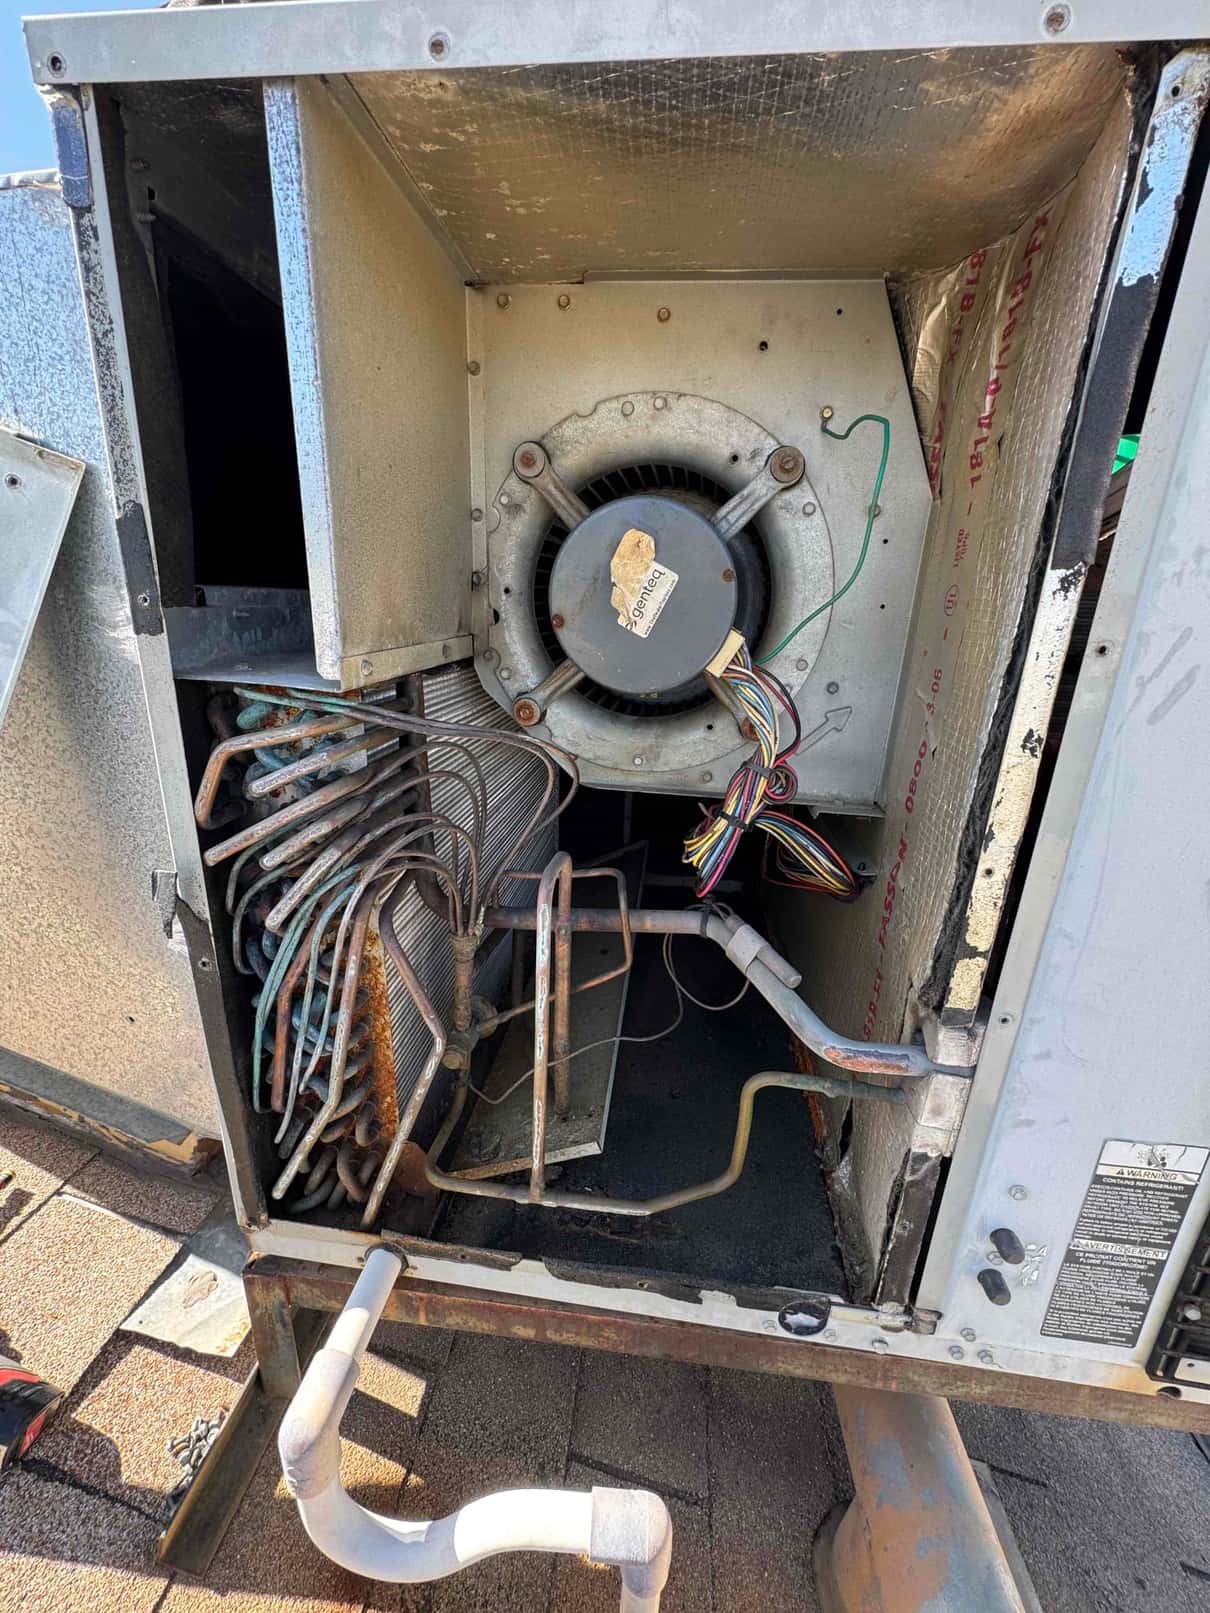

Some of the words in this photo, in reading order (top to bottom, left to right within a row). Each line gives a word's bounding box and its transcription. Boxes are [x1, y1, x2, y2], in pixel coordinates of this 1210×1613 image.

[632, 568, 666, 620] genteq
[1126, 1168, 1178, 1180] WARNING
[1102, 1177, 1134, 1186] CONTAINS
